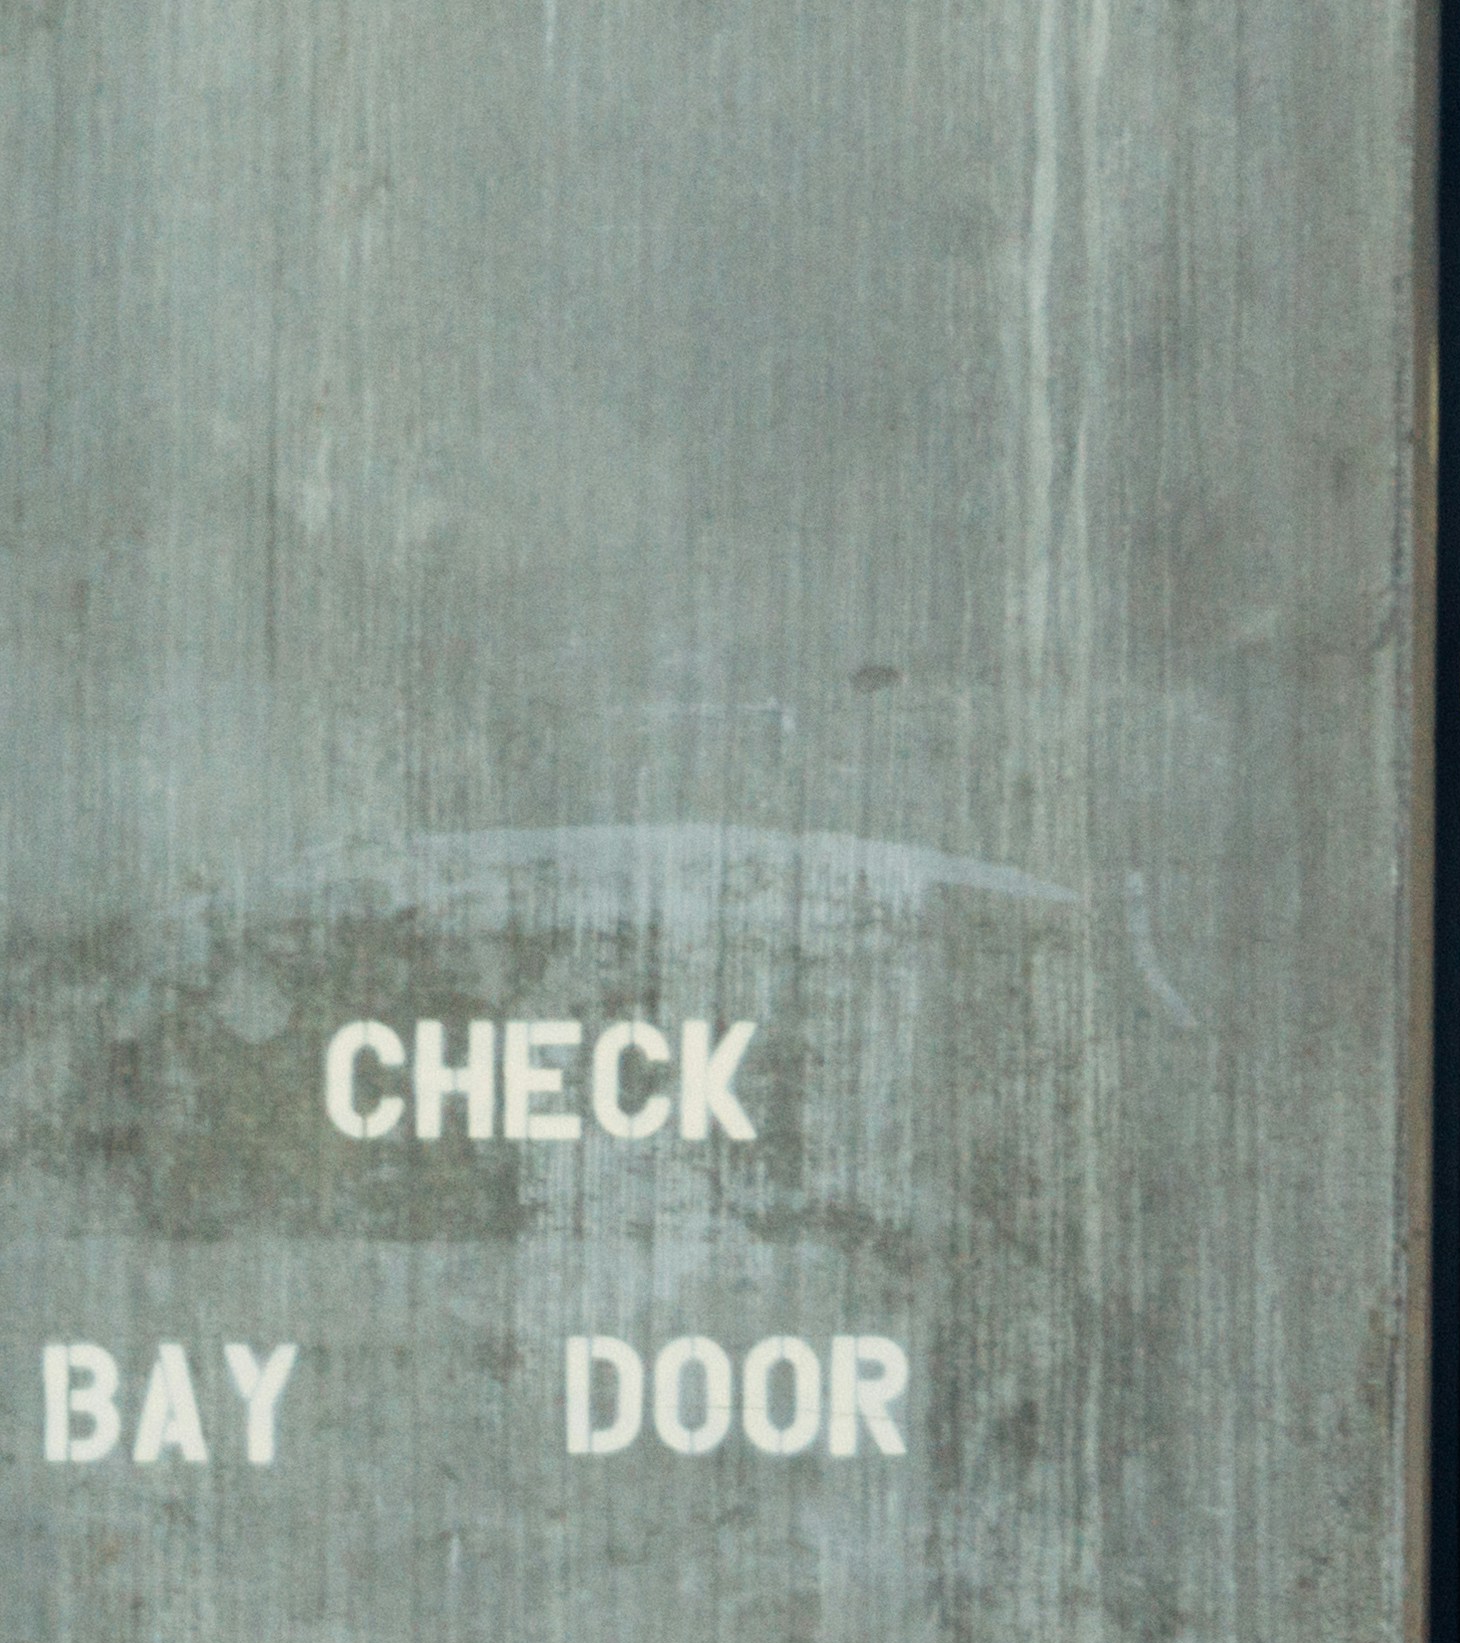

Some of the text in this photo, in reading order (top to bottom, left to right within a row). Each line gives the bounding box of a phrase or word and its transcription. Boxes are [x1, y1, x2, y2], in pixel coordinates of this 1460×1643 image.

[325, 1019, 758, 1141] CHECK
[42, 1335, 909, 1464] BAY DOOR
